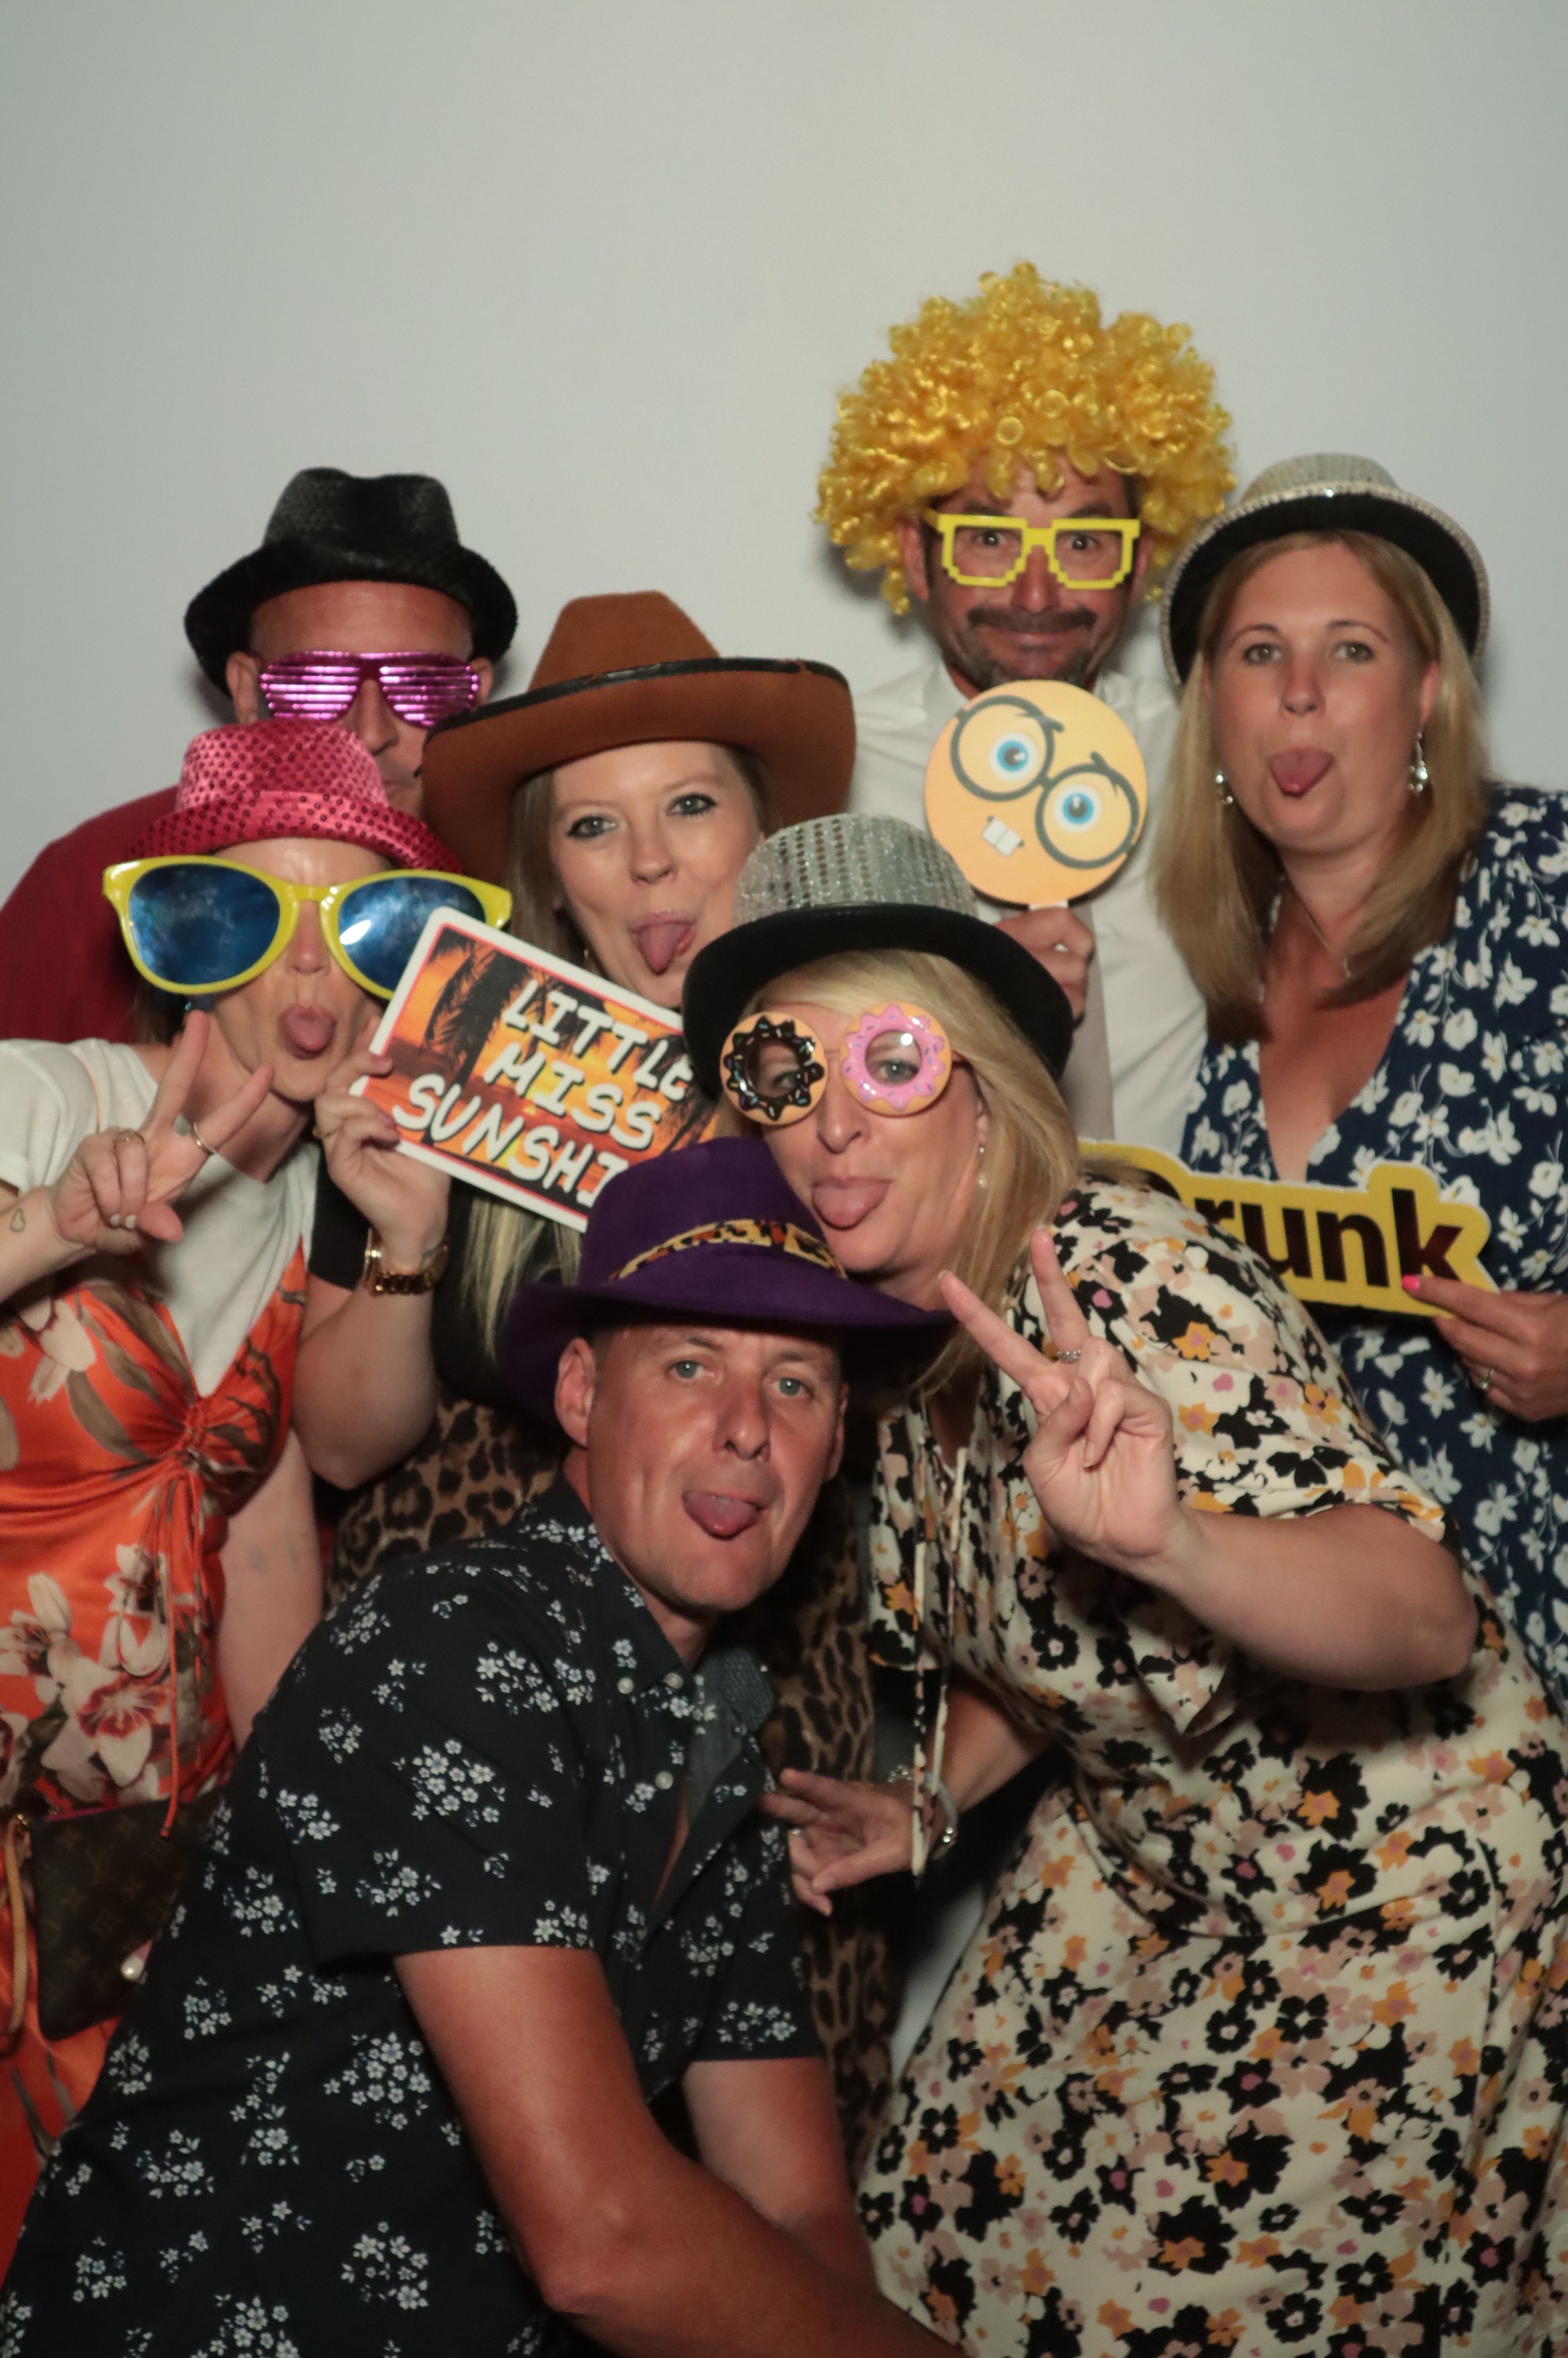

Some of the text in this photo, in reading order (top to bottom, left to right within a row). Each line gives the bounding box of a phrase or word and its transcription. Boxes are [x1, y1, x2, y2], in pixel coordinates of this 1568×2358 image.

[391, 1073, 629, 1209] SUNSHI
[483, 1042, 661, 1149] MISS
[1146, 1170, 1463, 1288] runk
